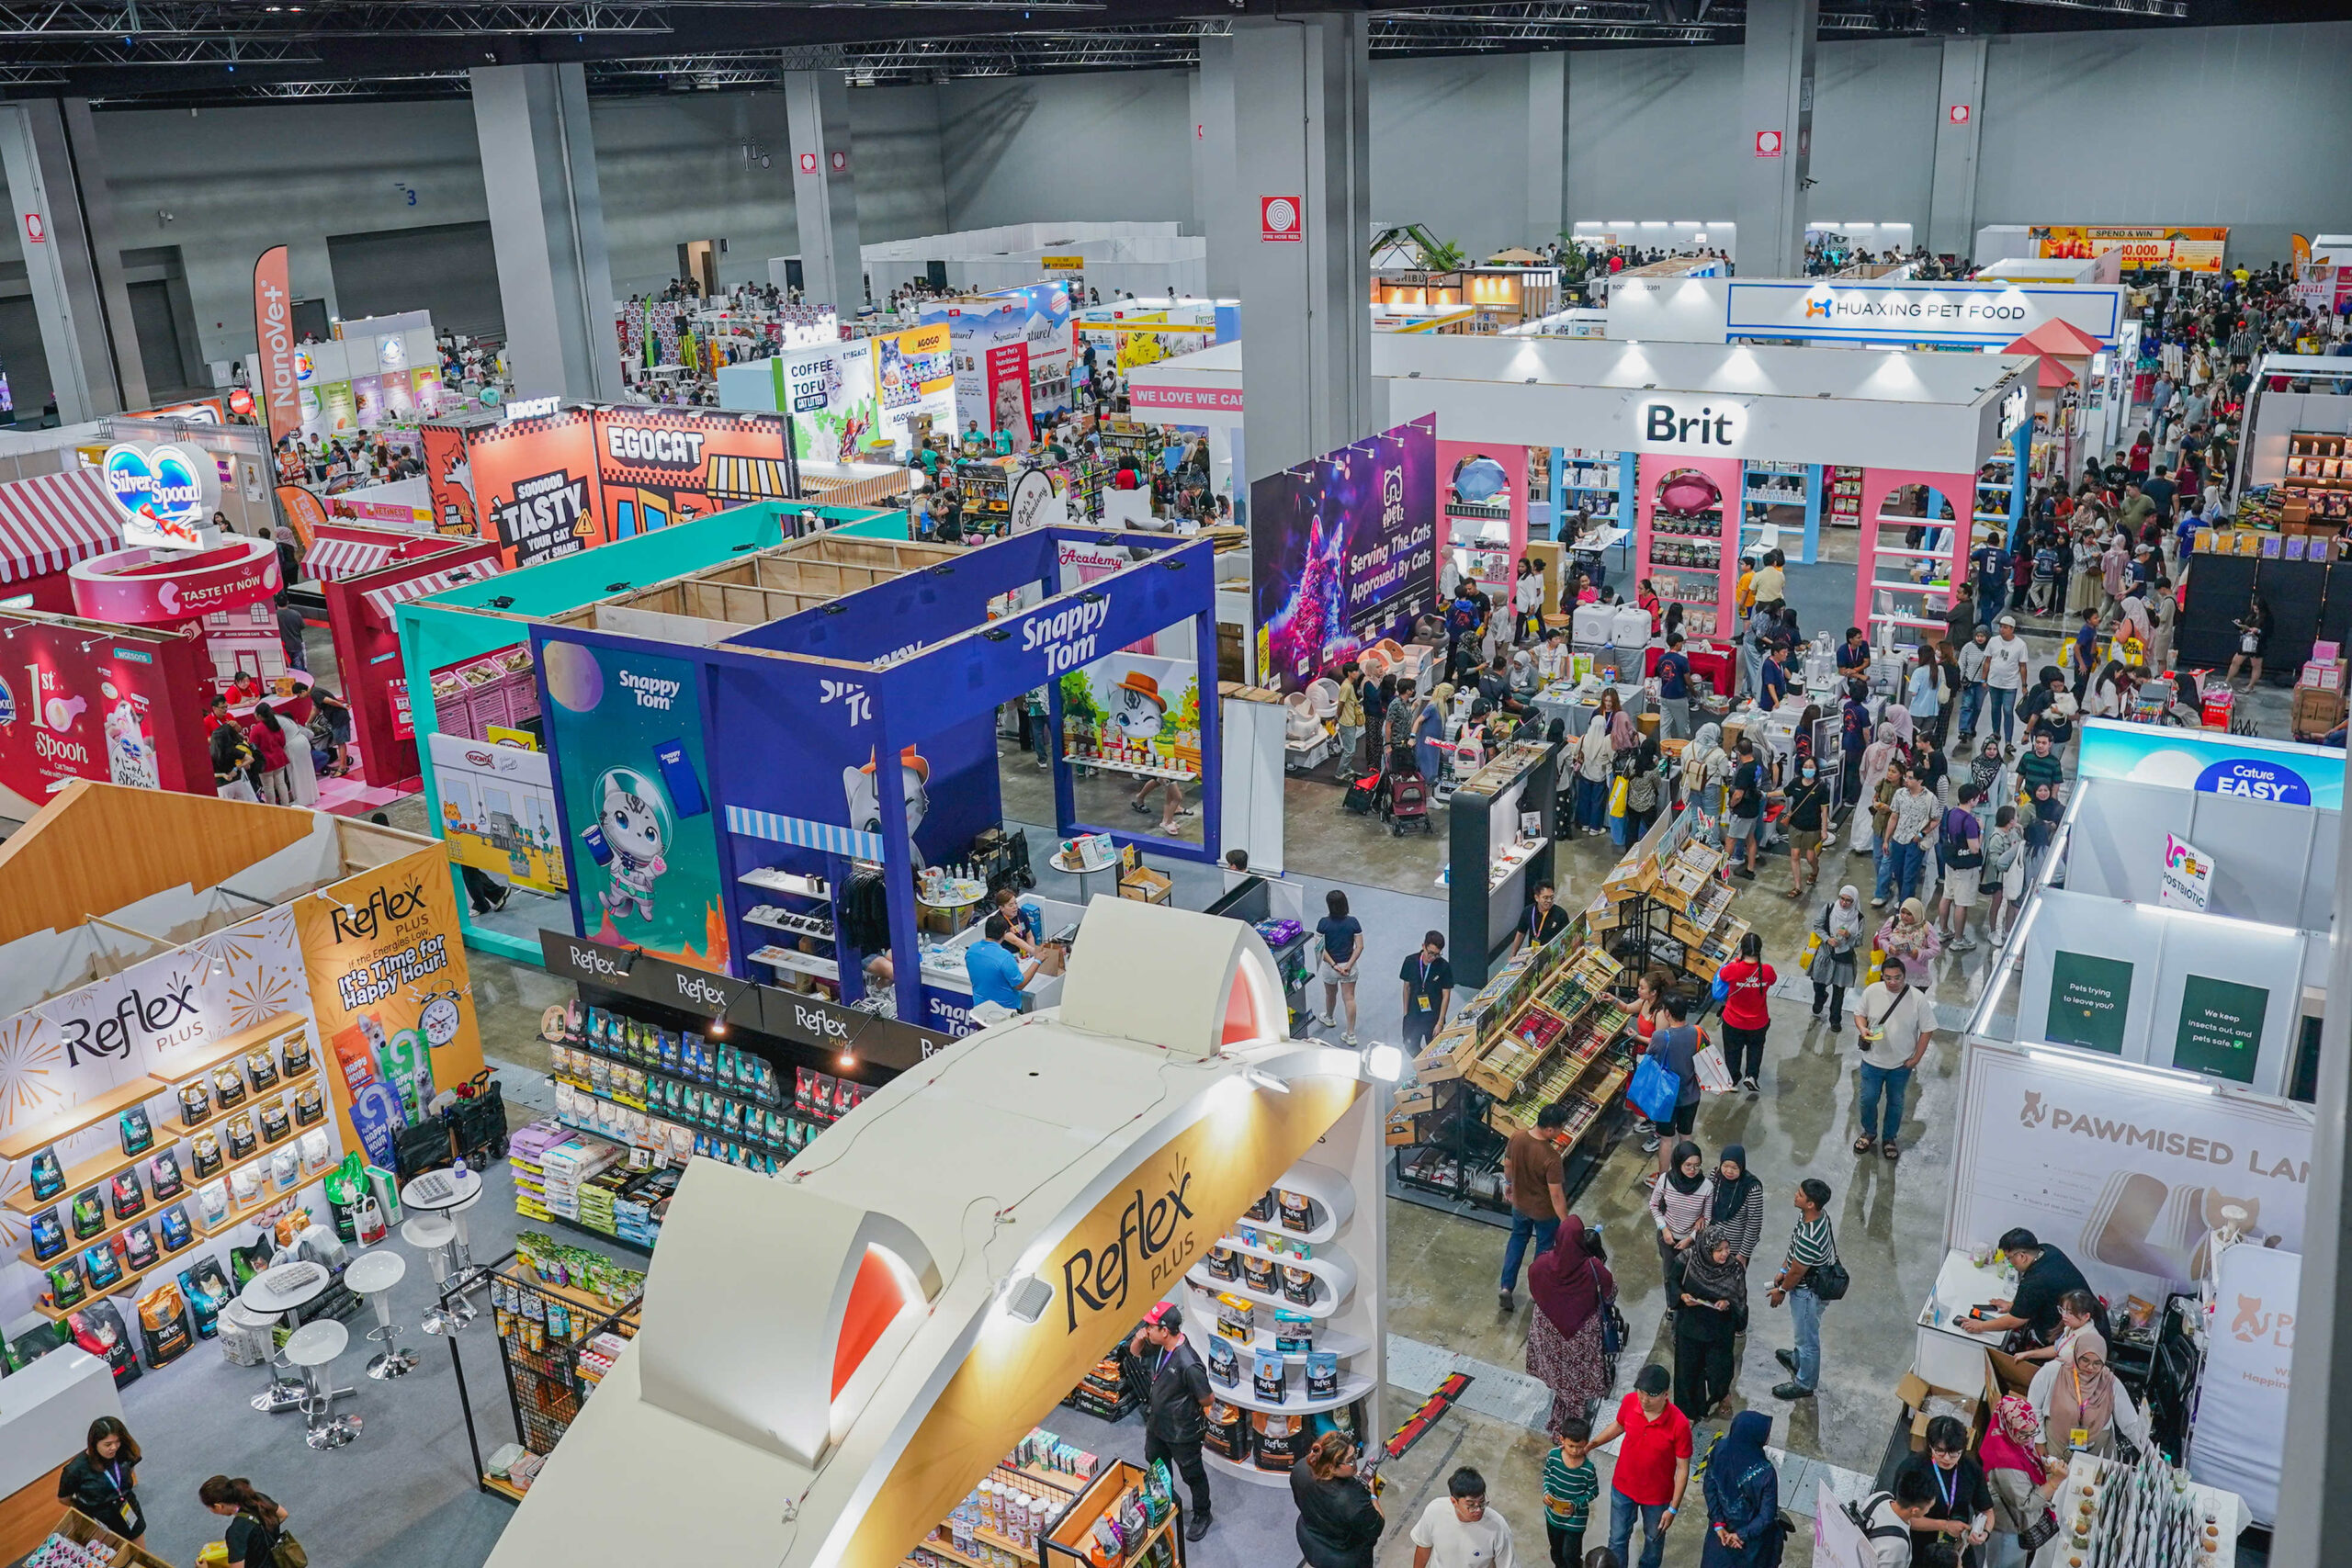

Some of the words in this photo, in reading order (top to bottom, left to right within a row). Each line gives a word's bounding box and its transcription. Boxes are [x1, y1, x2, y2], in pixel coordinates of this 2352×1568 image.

[406, 189, 417, 206] 3
[1837, 301, 1922, 317] HUAXING
[1928, 304, 1962, 318] PET
[1970, 306, 2025, 320] FOOD
[917, 336, 940, 348] AGOGO
[950, 329, 974, 340] ature7
[1027, 321, 1054, 343] ature7
[791, 359, 833, 378] COFFEE
[793, 379, 826, 396] TOFU
[1137, 390, 1158, 402] WE
[1159, 391, 1193, 403] LOVE
[1196, 392, 1216, 404] WE
[1646, 404, 1733, 445] Brit
[607, 425, 705, 467] EGOCAT
[110, 468, 152, 495] Silver
[151, 479, 201, 511] Spoon
[445, 504, 458, 516] MAY
[502, 481, 583, 543] TASTY
[526, 529, 551, 552] YOUR
[553, 526, 570, 544] CAT
[551, 540, 580, 560] SHARE!
[1351, 543, 1388, 576] Serving
[1392, 531, 1411, 554] The
[1411, 523, 1431, 545] Cats
[1058, 547, 1124, 571] Academy
[1986, 555, 1996, 574] 6
[1350, 567, 1396, 604] Approved
[1398, 558, 1410, 580] By
[1412, 549, 1431, 570] Cats
[182, 584, 222, 602] TASTE
[223, 583, 234, 594] IT
[235, 575, 261, 592] NOW
[1022, 592, 1112, 652] Snappy
[1043, 632, 1098, 677] Tom
[619, 670, 680, 698] Snappy
[634, 688, 674, 711] Tom
[35, 731, 89, 764] Spoon
[2233, 764, 2275, 782] Cature
[2215, 776, 2290, 802] EASY
[2163, 872, 2205, 908] POSTBIOTIC
[330, 884, 427, 944] Reflex
[395, 913, 429, 936] PLUS
[356, 953, 372, 966] the
[373, 937, 411, 959] Energies
[412, 928, 431, 942] Low,
[338, 968, 368, 996] It's
[370, 947, 416, 979] Time
[419, 934, 445, 958] for
[570, 945, 617, 976] Reflex
[342, 971, 399, 1011] Happy
[401, 949, 448, 985] Hour!
[601, 975, 618, 986] PLUS
[676, 973, 727, 1006] Reflex
[2069, 983, 2086, 994] Pets
[2088, 987, 2111, 998] trying
[930, 998, 978, 1023] Snap
[2064, 995, 2072, 1003] to
[2073, 997, 2094, 1007] leave
[2095, 1000, 2114, 1010] you?
[62, 984, 199, 1069] Reflex
[795, 1004, 848, 1039] Reflex
[2204, 1009, 2218, 1019] We
[2220, 1011, 2240, 1023] keep
[156, 1020, 204, 1053] PLUS
[2188, 1019, 2218, 1032] insects
[2235, 1029, 2253, 1039] and
[2192, 1034, 2211, 1044] pets
[2211, 1037, 2233, 1048] safe.
[345, 1056, 368, 1076] HAPPY
[347, 1067, 368, 1085] HOUR
[395, 1072, 413, 1088] APPY
[397, 1083, 412, 1098] OUR
[365, 1123, 388, 1145] HAPPY
[368, 1136, 388, 1153] HOUR
[2052, 1107, 2233, 1168] PAWMISED
[1062, 1171, 1195, 1336] Reflex
[1151, 1230, 1195, 1291] PLUS
[204, 1292, 231, 1312] Reflex
[158, 1323, 179, 1340] Reflex
[1259, 1380, 1276, 1391] Reflex
[1314, 1379, 1331, 1389] Reflex
[2242, 1371, 2290, 1389] Happin
[1264, 1438, 1289, 1450] Reflex
